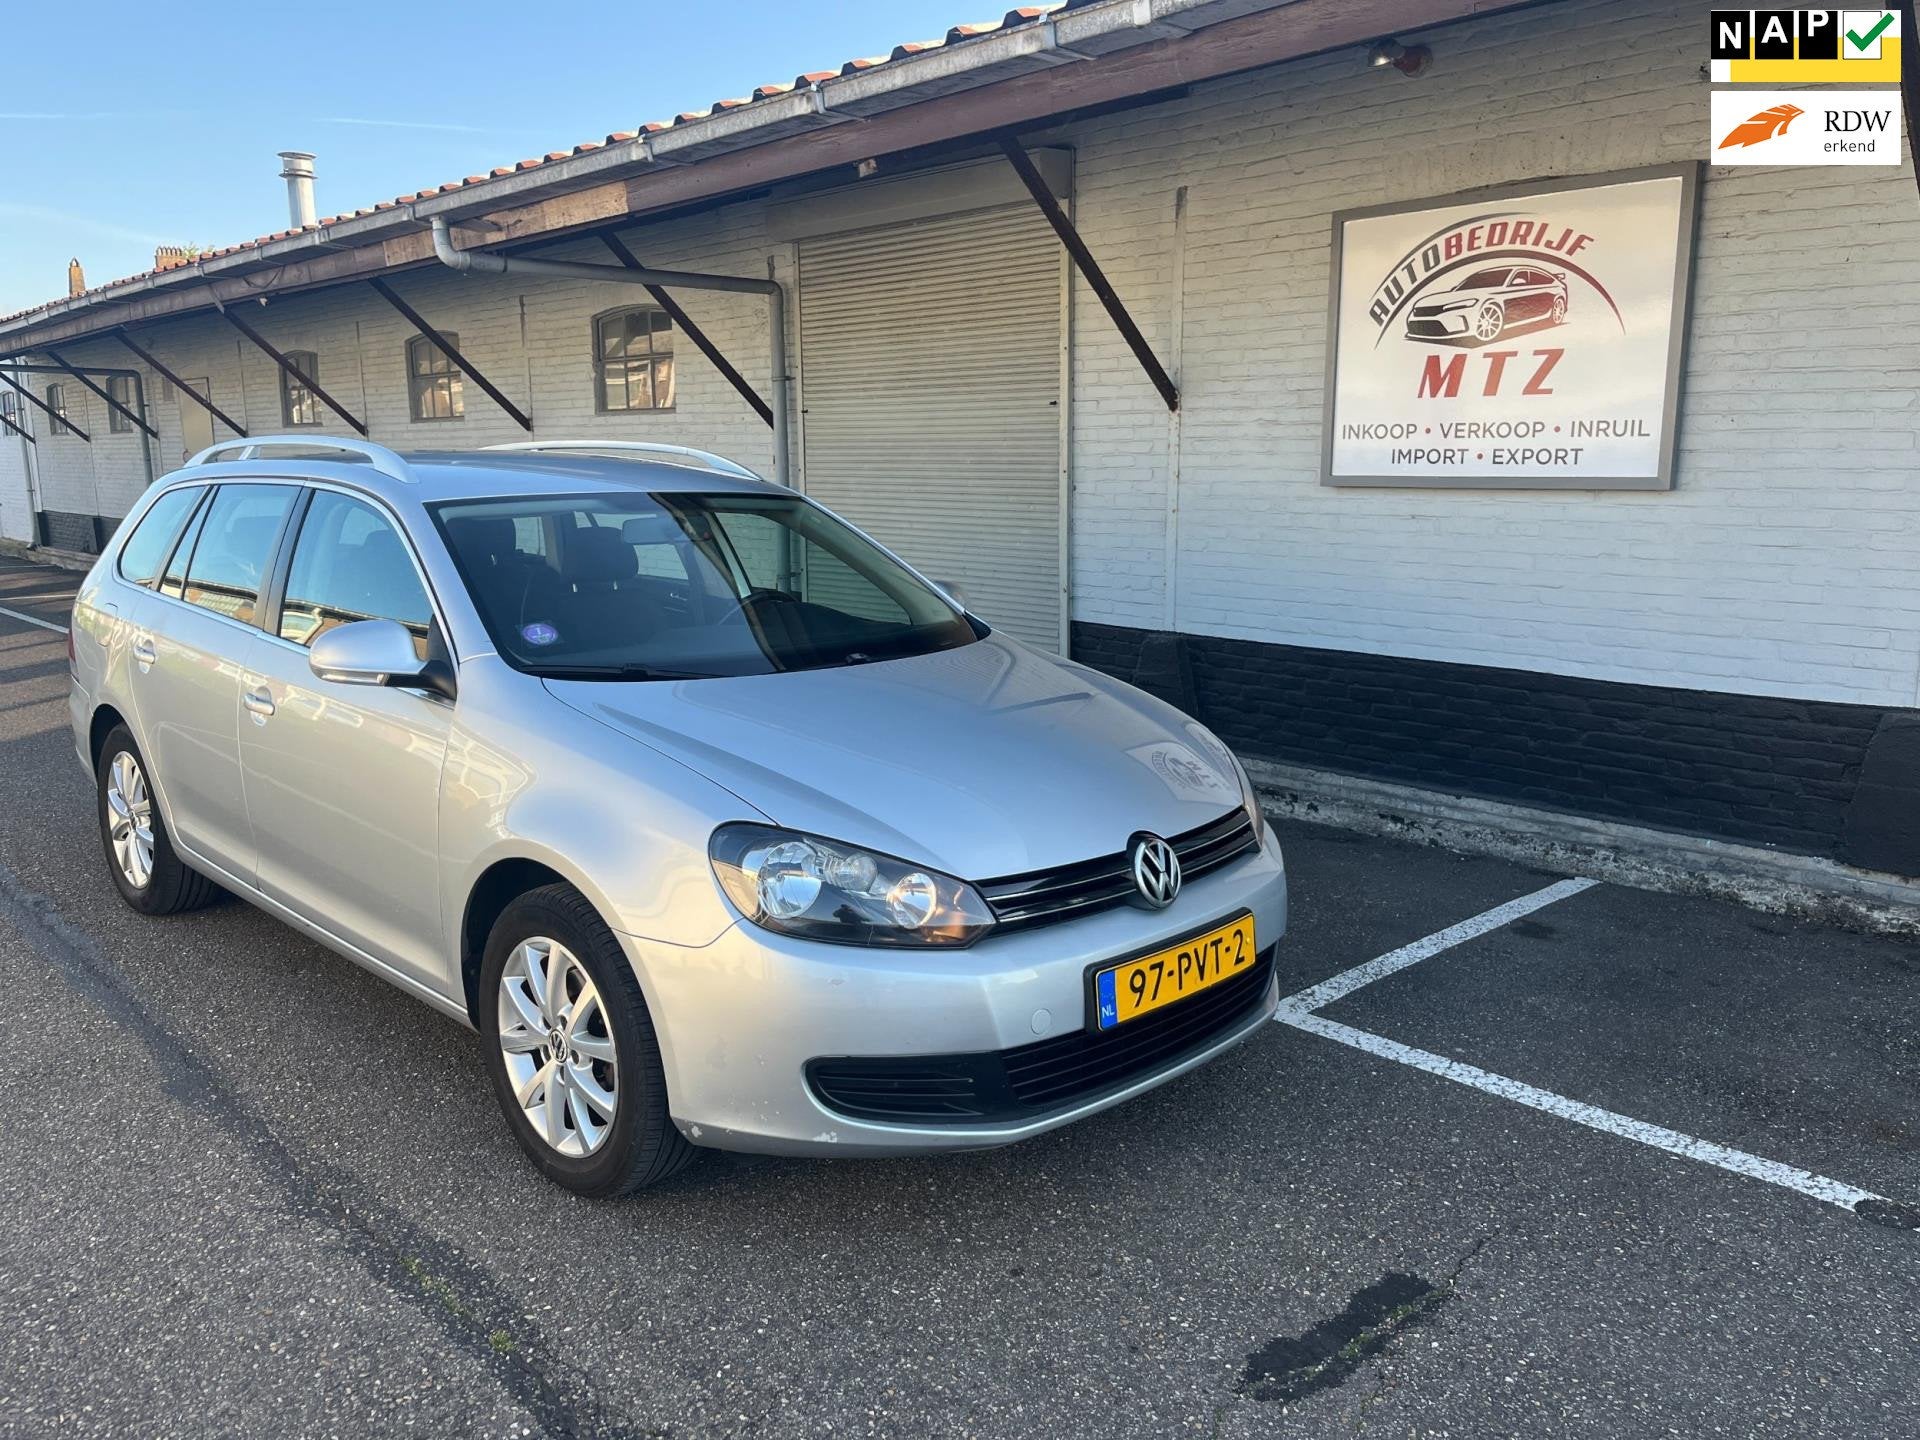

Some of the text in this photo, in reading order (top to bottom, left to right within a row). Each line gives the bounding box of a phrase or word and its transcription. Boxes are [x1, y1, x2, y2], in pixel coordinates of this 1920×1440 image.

[1417, 348, 1565, 399] MTZ
[1342, 419, 1651, 440] INKOOP VERKOOP INRUIL
[1391, 448, 1584, 466] IMPORT EXPORT
[1101, 928, 1245, 1019] NL 97-PVT-2
